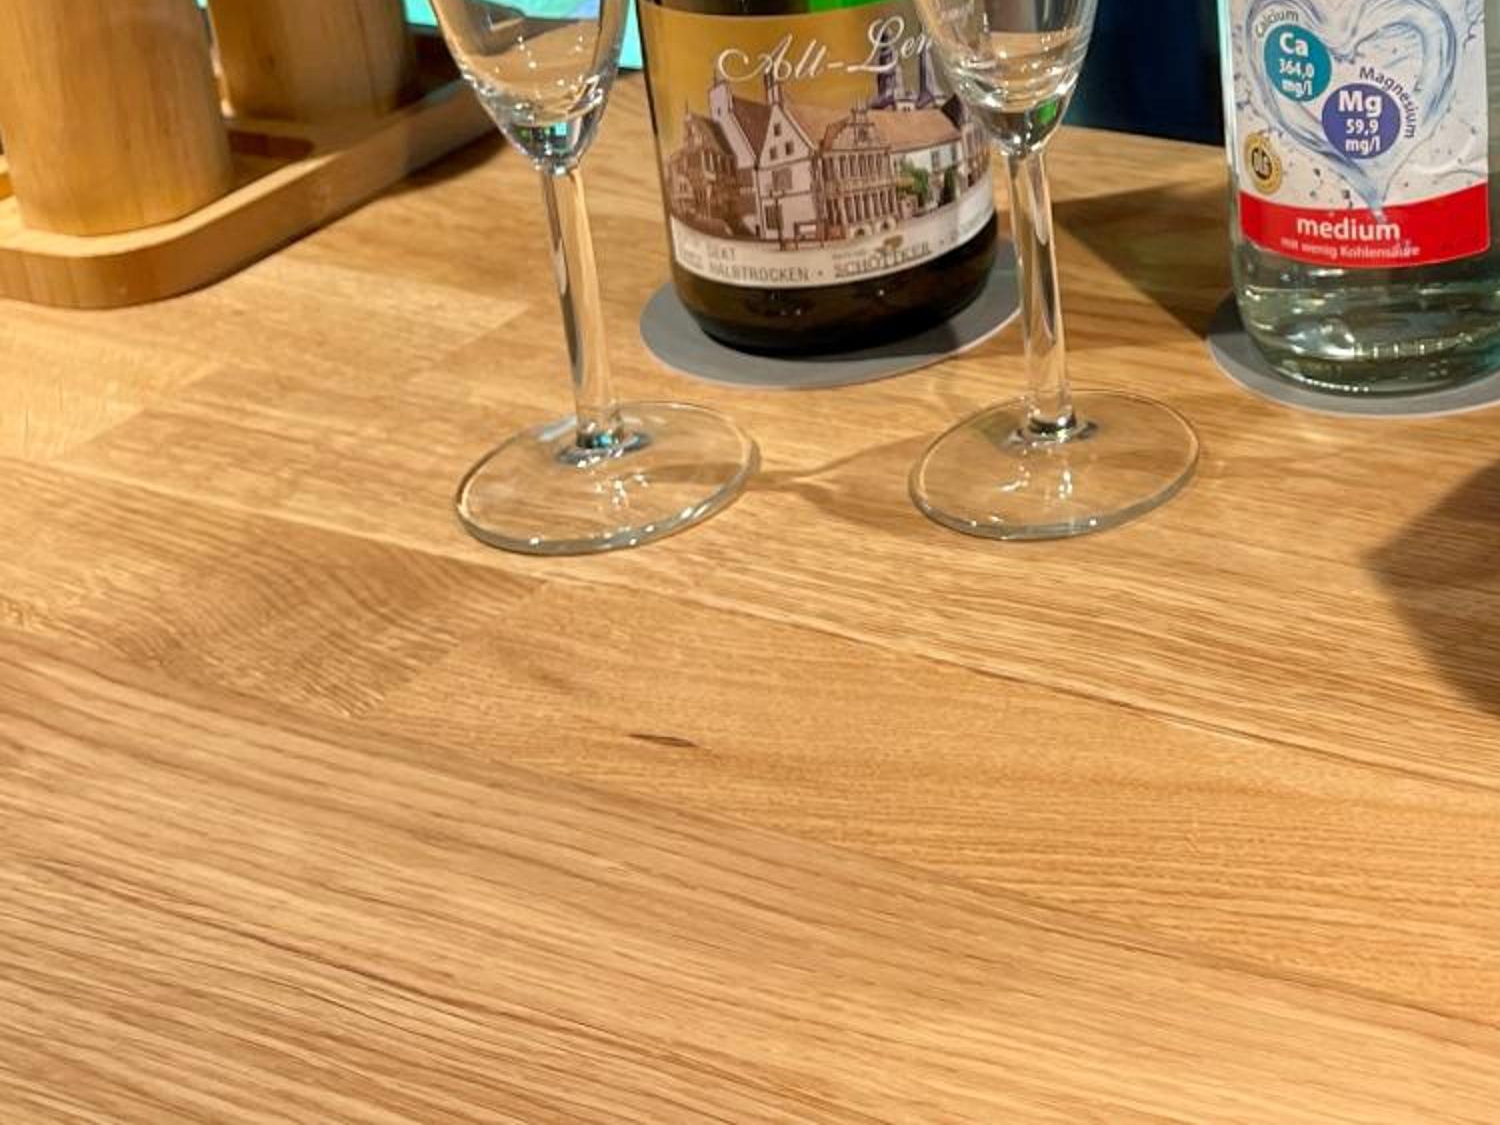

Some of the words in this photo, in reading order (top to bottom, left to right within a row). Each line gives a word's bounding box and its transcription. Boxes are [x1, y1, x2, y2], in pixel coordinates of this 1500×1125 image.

[1279, 31, 1309, 58] Ca
[1337, 89, 1383, 118] Mg
[1358, 65, 1419, 139] Magnesium
[1345, 117, 1379, 136] 59,9
[1344, 135, 1381, 156] mg/l
[1296, 216, 1401, 241] medium
